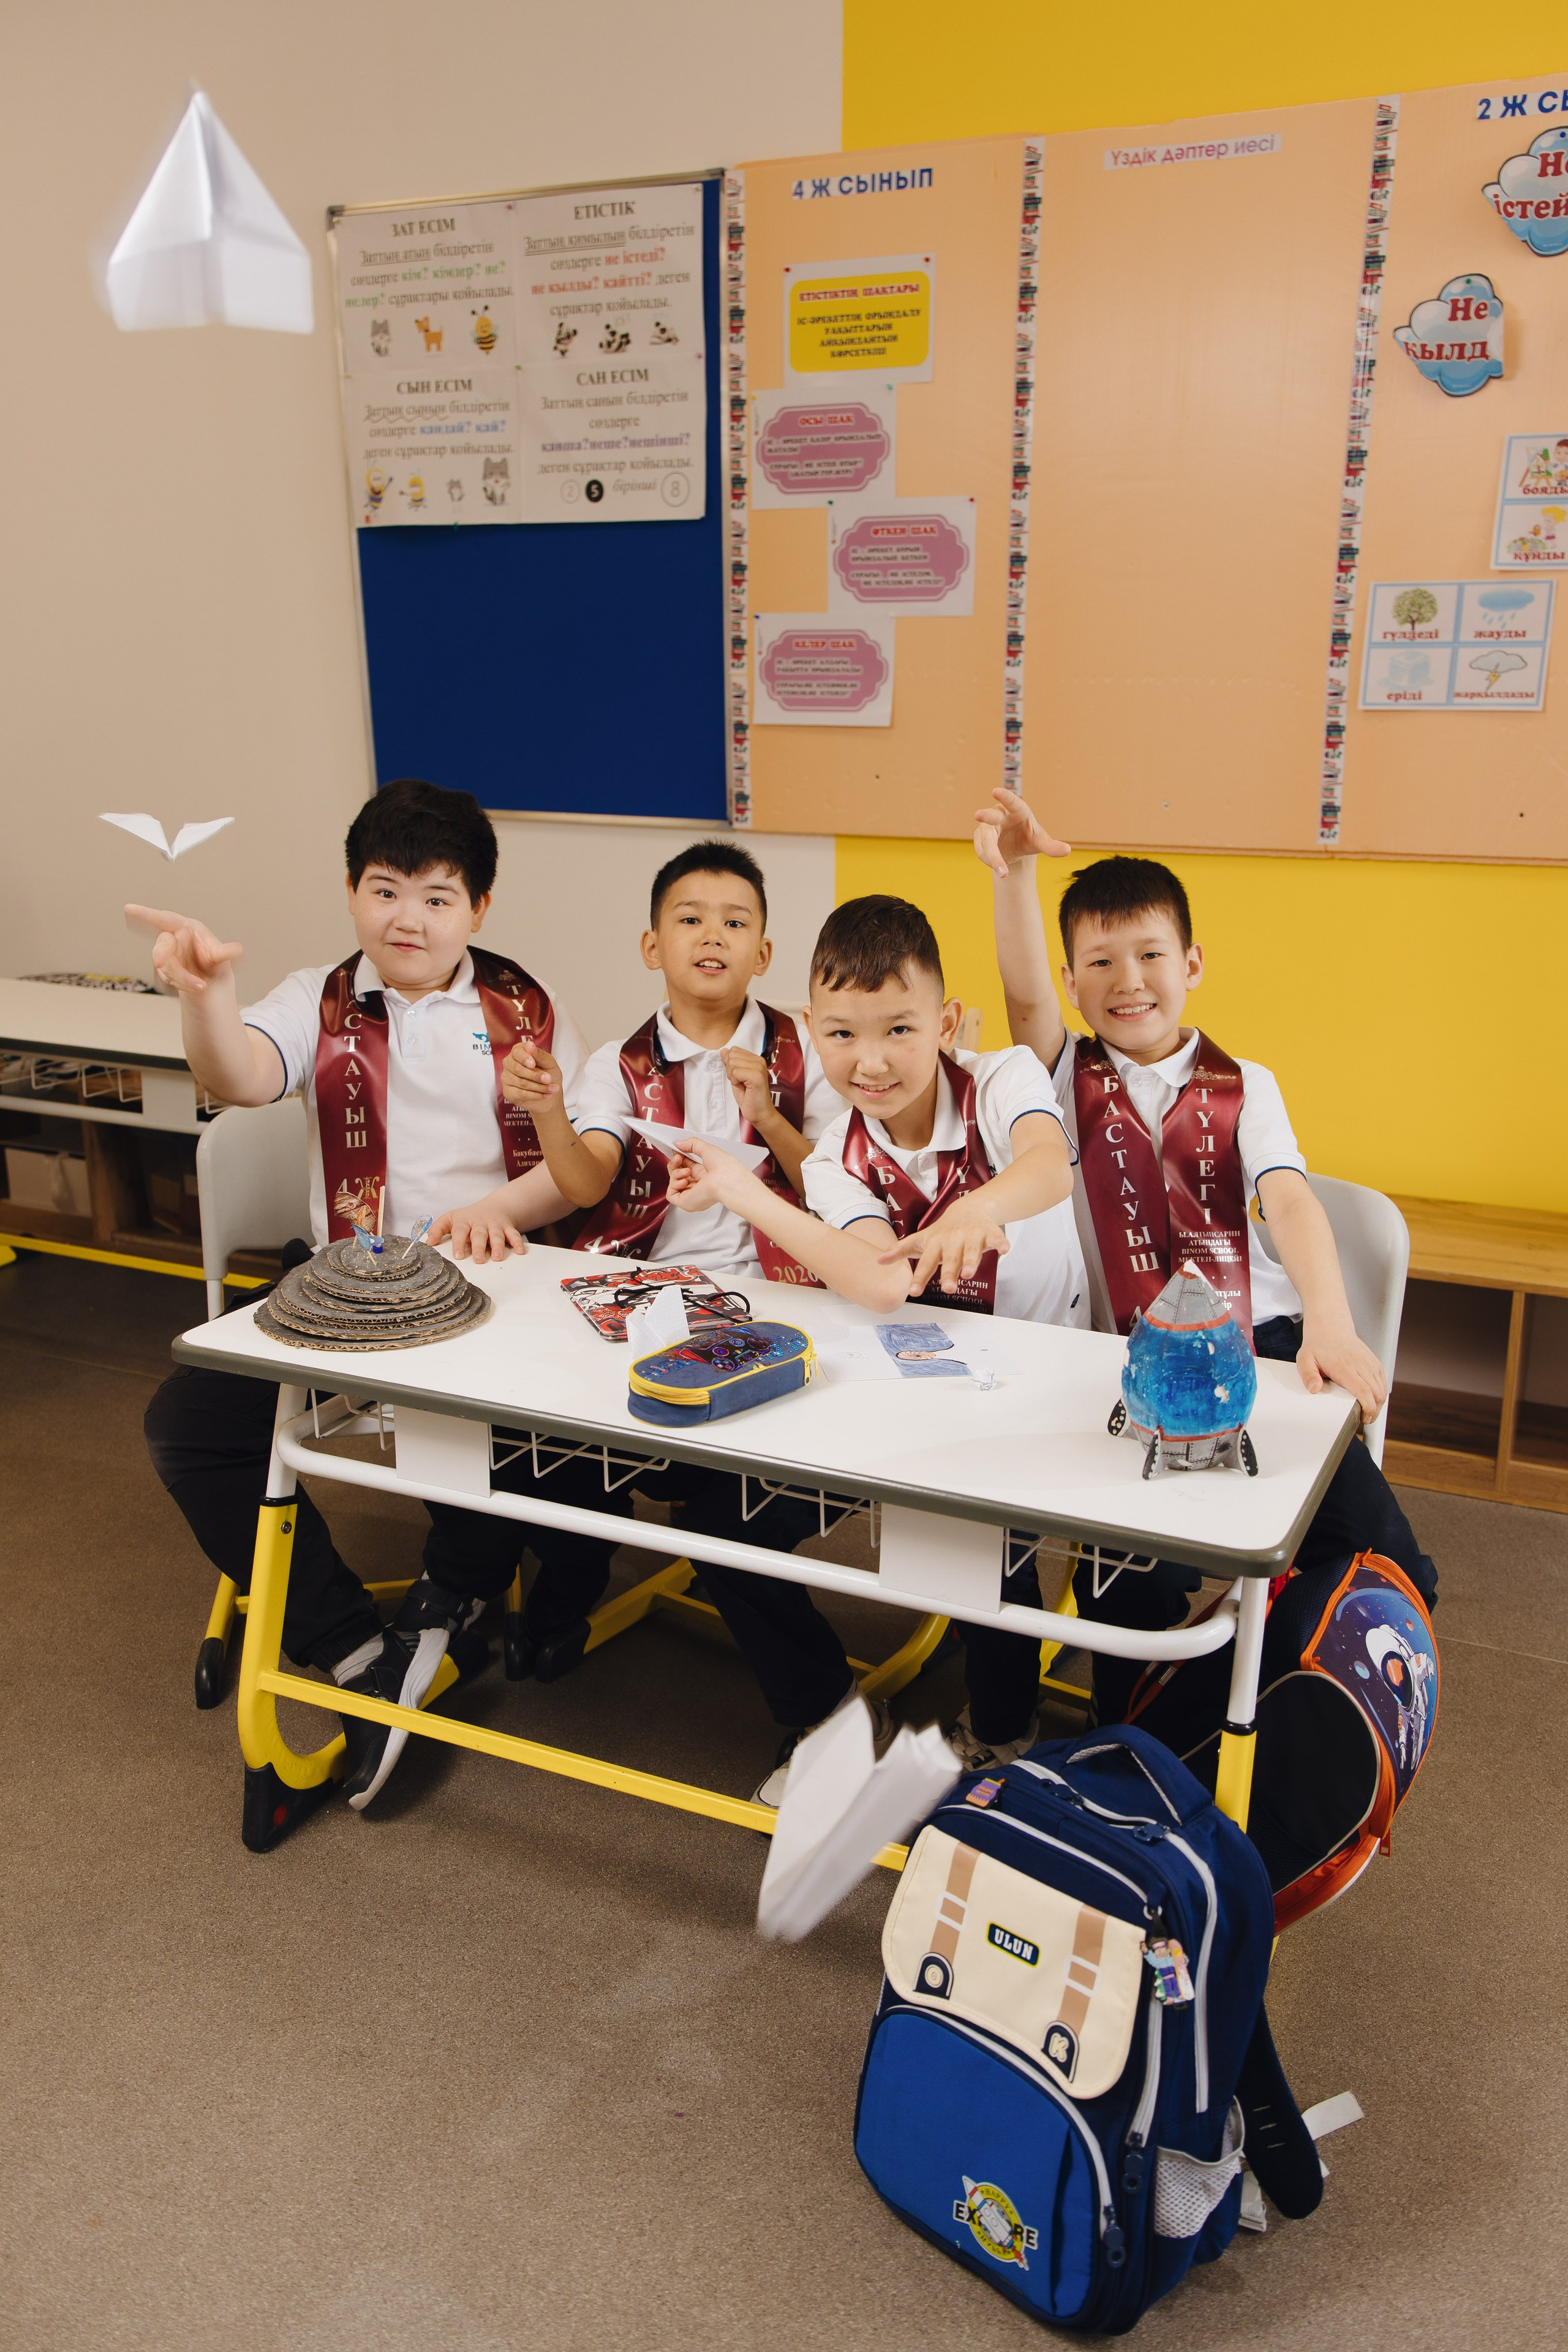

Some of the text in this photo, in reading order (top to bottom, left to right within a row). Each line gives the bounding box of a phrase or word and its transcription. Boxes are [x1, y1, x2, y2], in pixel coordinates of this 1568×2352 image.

[1477, 98, 1491, 119] 2
[1500, 94, 1527, 118] Ж
[1110, 134, 1275, 167] Үздік дәптер иесі
[1538, 151, 1568, 178] Н
[794, 168, 932, 200] 4 Ж СЫНЫП
[573, 201, 636, 220] ЕТІСТІК
[391, 218, 455, 237] ЗАТ ЕСІМ
[1449, 298, 1488, 321] Не
[397, 379, 473, 394] СЫН ЕСІМ
[576, 368, 649, 386] САН ЕСІМ
[590, 483, 600, 497] 5
[671, 480, 680, 498] 8
[1382, 629, 1526, 640] гүлдеді жауды
[1387, 690, 1422, 702] еріді
[1196, 1088, 1216, 1225] ТҮЛЕГІ
[1102, 1075, 1161, 1273] БАСТАУЫШ
[584, 1235, 603, 1254] 4
[952, 1295, 985, 1306] SCHOOL
[993, 1928, 1034, 1961] ULUN
[1048, 2032, 1069, 2063] K
[955, 2202, 1036, 2247] EXRE
